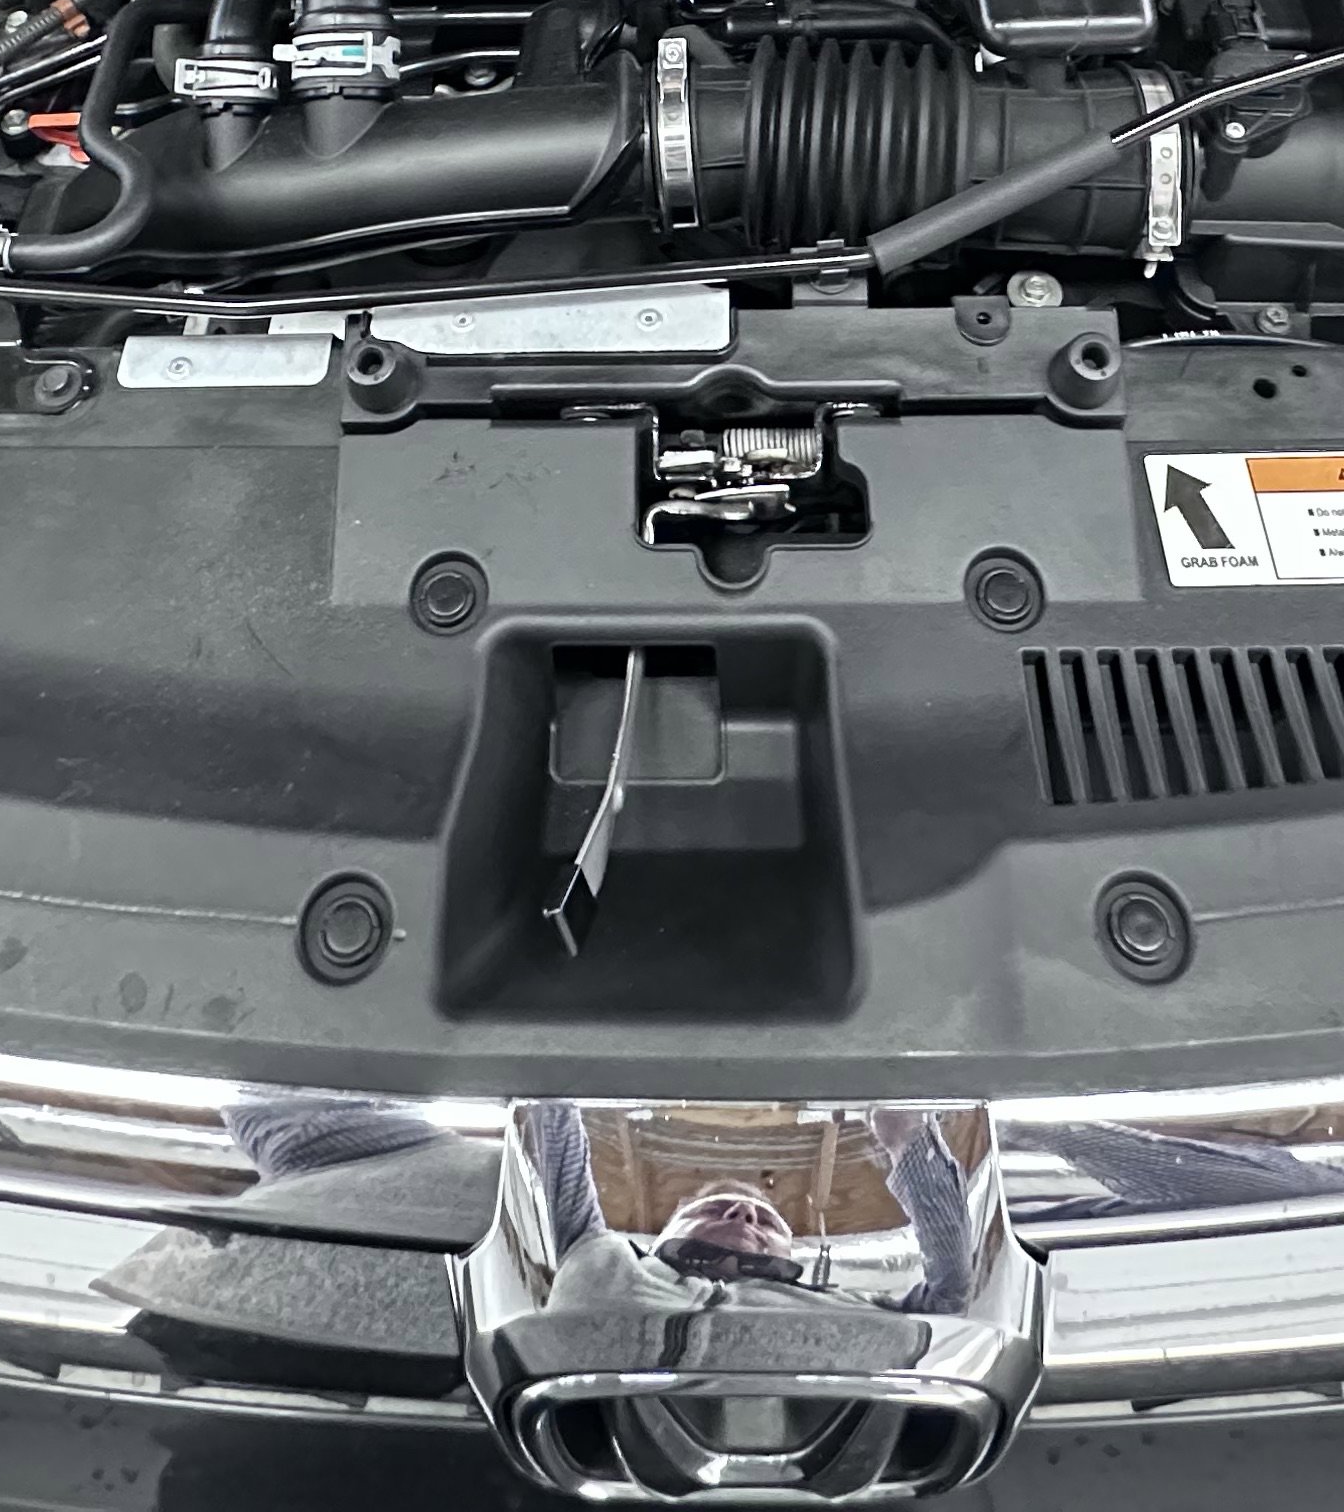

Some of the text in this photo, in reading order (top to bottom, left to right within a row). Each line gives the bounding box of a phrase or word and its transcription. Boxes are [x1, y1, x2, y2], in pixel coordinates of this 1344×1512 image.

[1316, 507, 1330, 517] Do
[1181, 555, 1259, 568] GRAB FOAM
